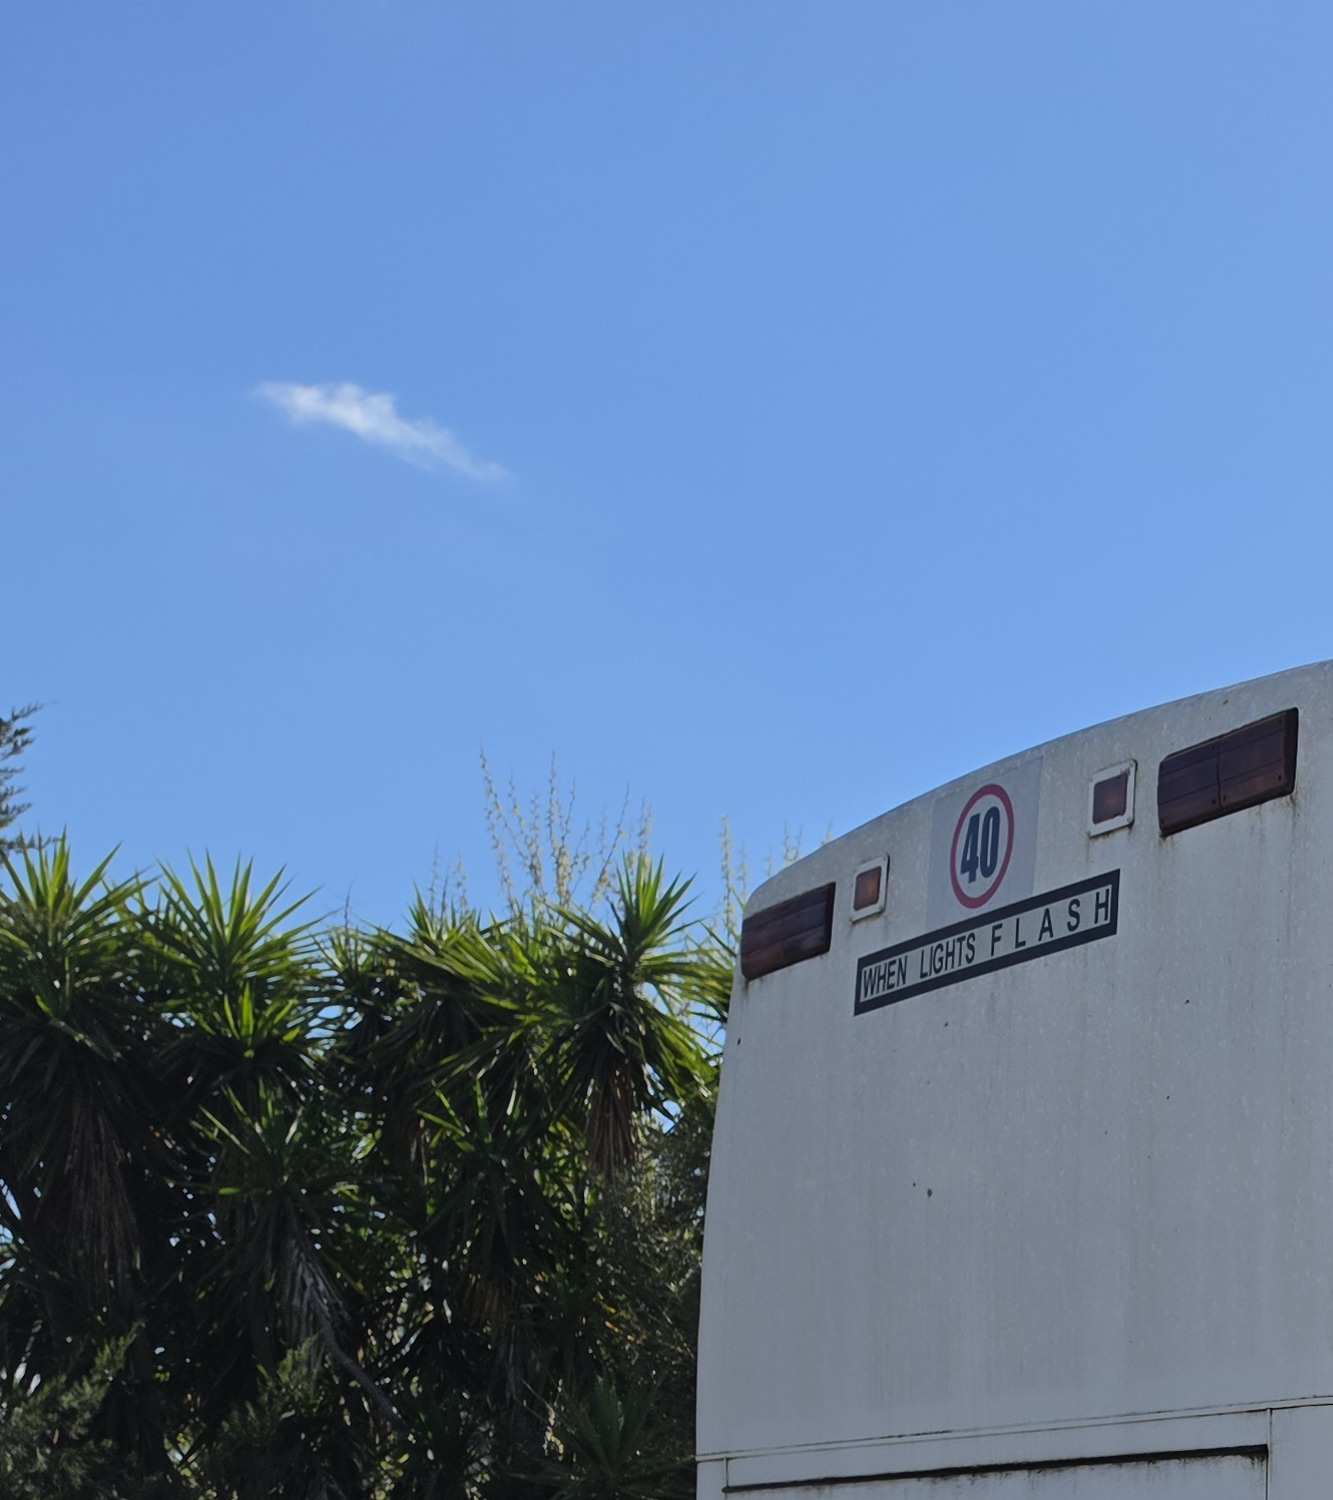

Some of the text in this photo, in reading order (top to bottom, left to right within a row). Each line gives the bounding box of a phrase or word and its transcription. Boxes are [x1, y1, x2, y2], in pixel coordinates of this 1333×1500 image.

[959, 805, 1001, 884] 40
[862, 887, 1111, 999] WHEN LIGHTS FLASH
